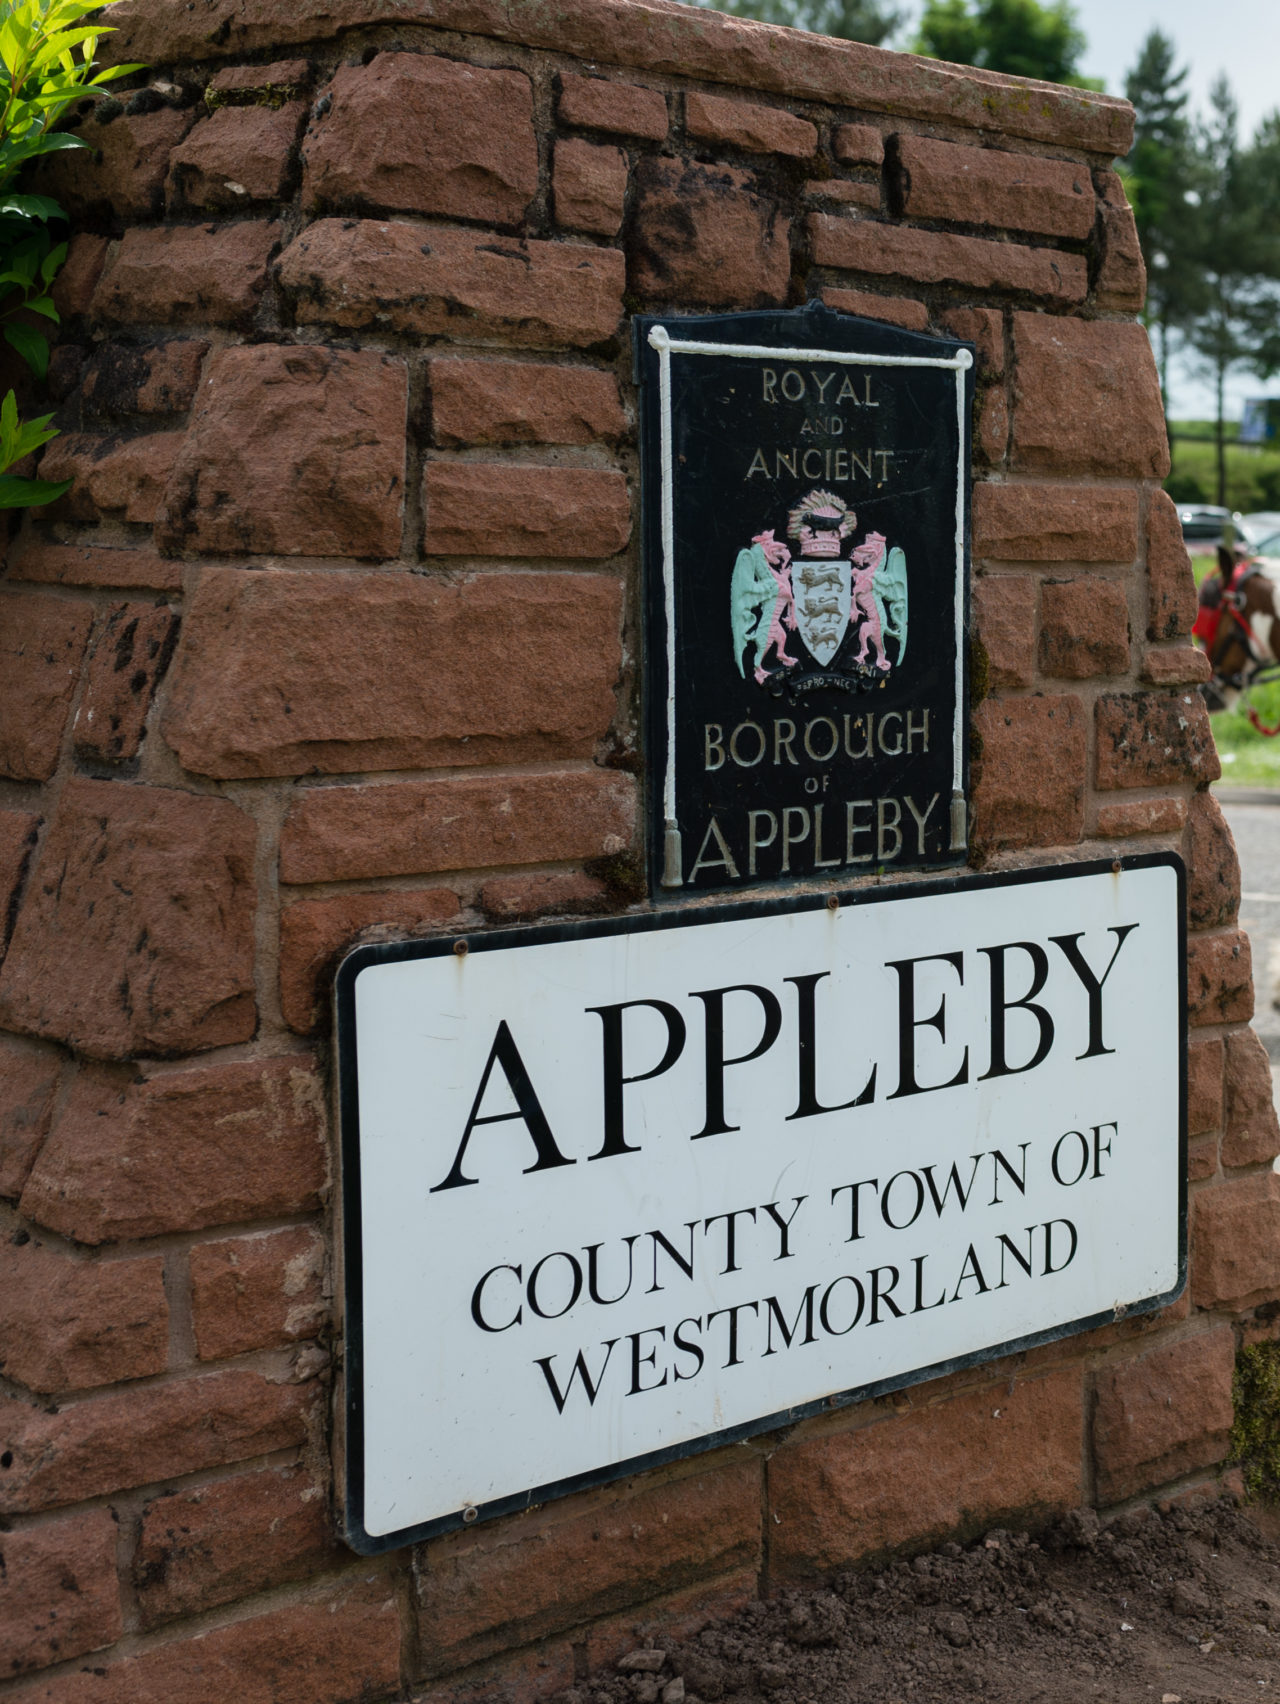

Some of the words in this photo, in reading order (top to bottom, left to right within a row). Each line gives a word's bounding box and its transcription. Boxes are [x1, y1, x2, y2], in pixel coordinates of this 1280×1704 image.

[762, 367, 880, 407] ROYAL
[800, 416, 844, 435] AND
[745, 447, 895, 482] ANCIENT
[704, 708, 930, 770] BOROUGH
[804, 774, 831, 794] OF
[687, 792, 941, 883] APPLEBY
[429, 922, 1141, 1194] APPLEBY
[470, 1195, 808, 1333] COUNTY
[830, 1143, 1033, 1244] TOWN
[1050, 1121, 1120, 1187] OF
[532, 1217, 1079, 1415] WESTMORLAND
